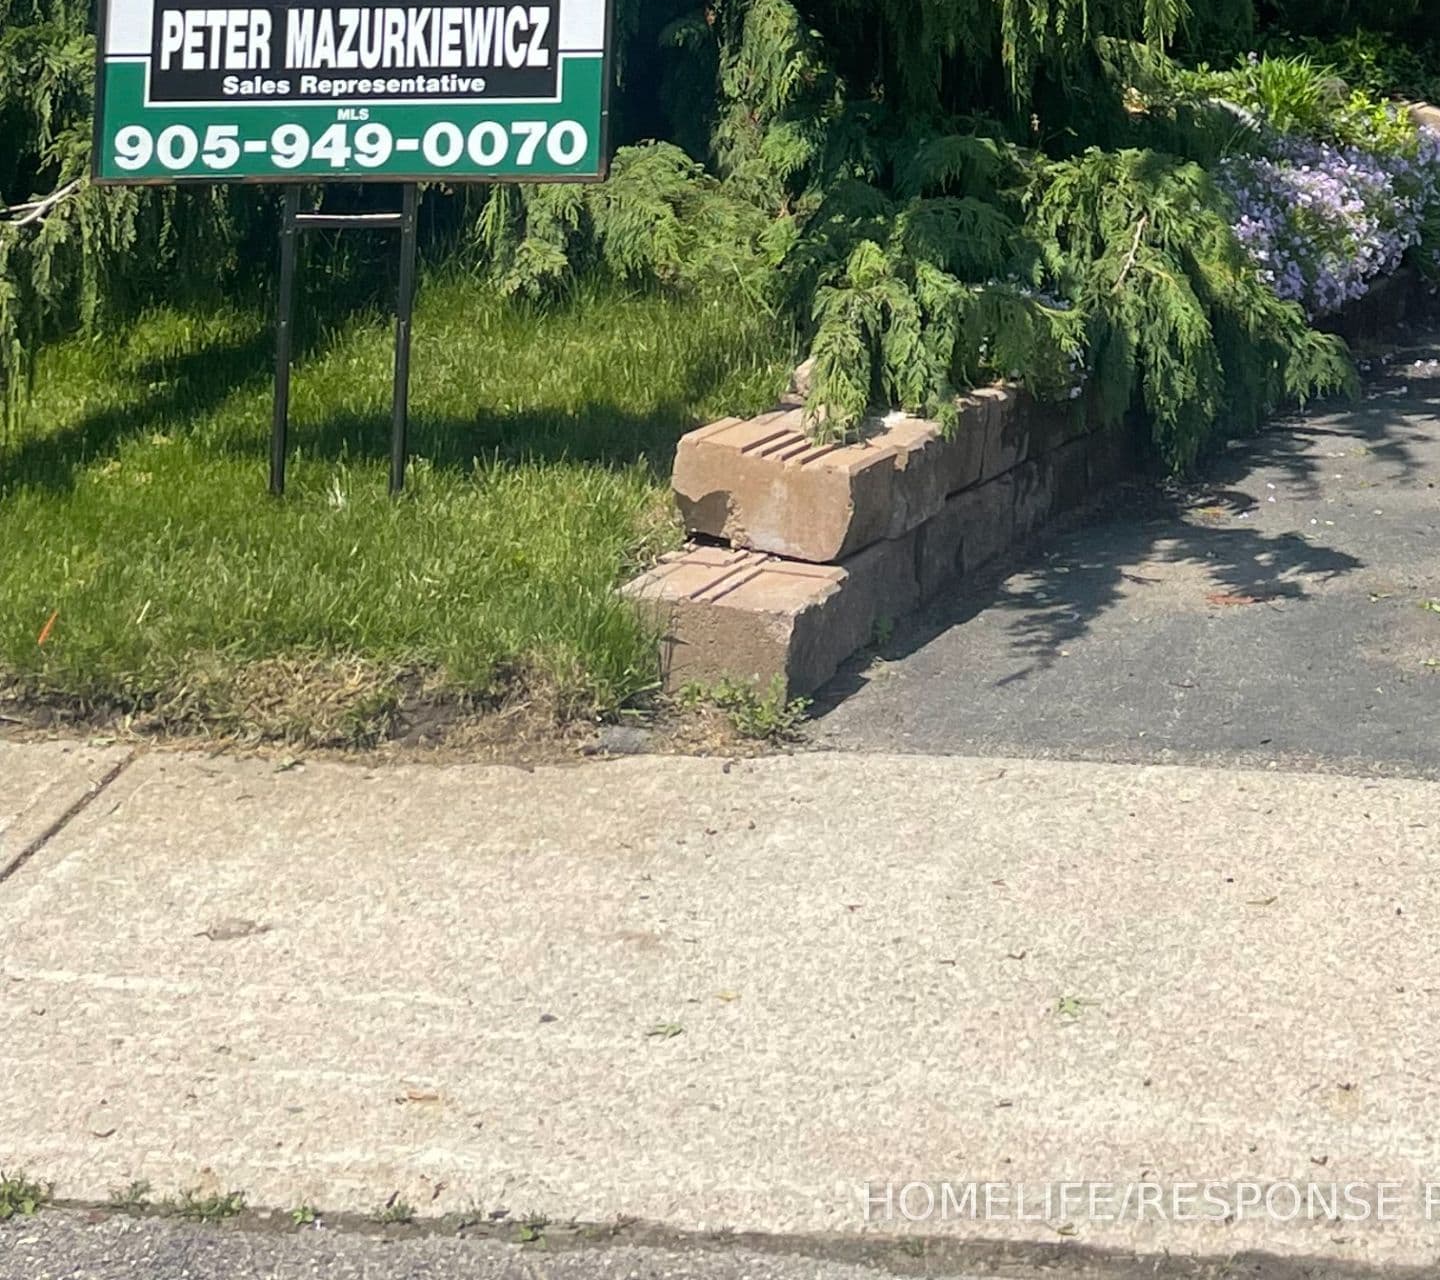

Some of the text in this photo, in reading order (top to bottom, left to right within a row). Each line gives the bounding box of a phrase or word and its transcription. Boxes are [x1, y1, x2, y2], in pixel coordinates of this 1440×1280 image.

[160, 6, 550, 70] PETER MAZURKIEWICZ
[223, 75, 485, 96] Sales Representative
[337, 109, 369, 121] MLS
[113, 120, 588, 170] 905-949-0070
